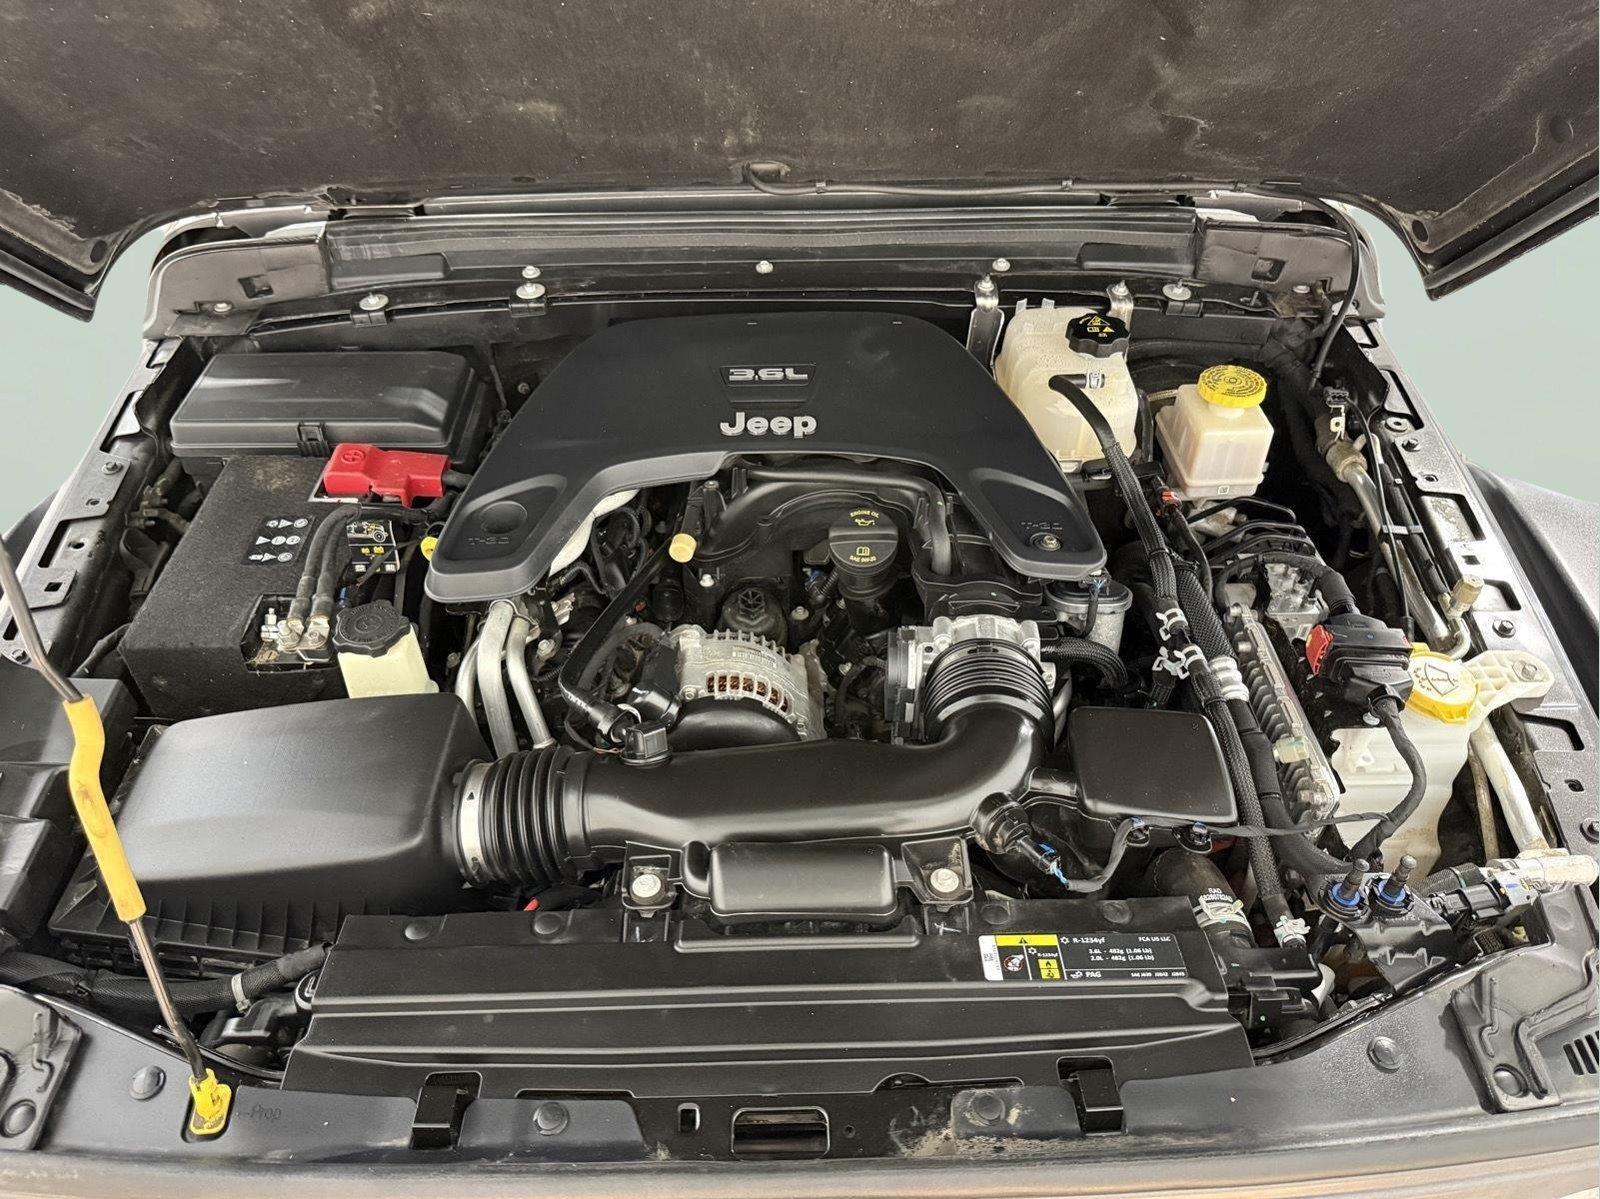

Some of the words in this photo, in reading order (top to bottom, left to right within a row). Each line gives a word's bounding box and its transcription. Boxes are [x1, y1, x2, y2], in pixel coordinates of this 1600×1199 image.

[728, 367, 808, 381] 3.6L
[719, 411, 817, 438] Jeep
[1072, 936, 1105, 944] R-1234yf
